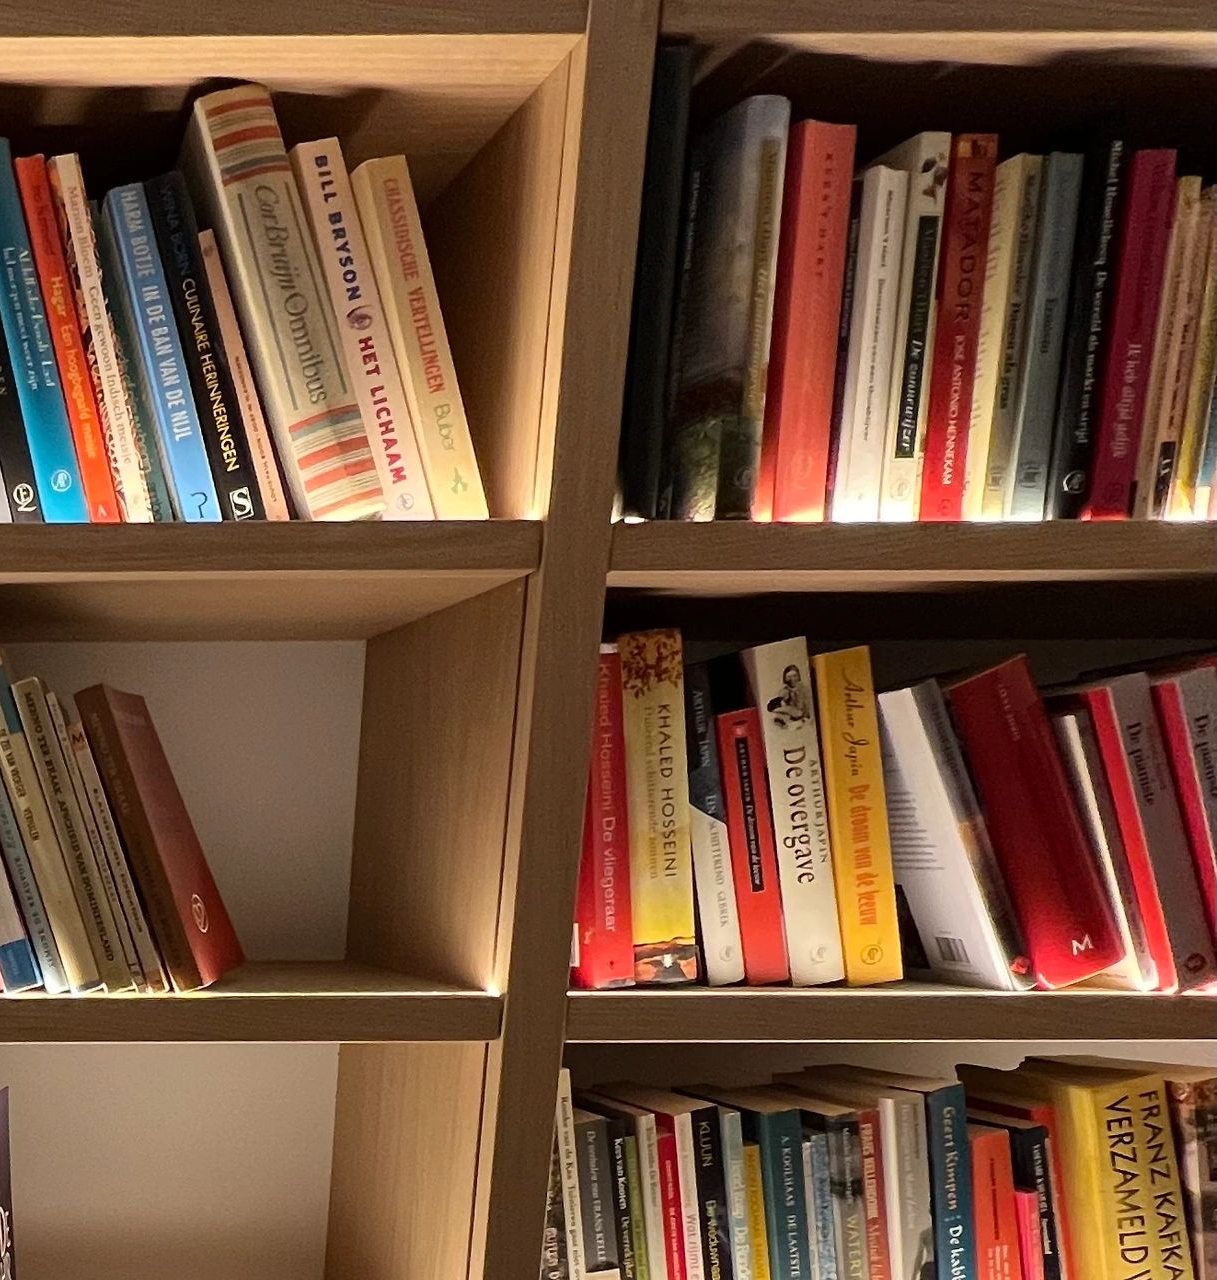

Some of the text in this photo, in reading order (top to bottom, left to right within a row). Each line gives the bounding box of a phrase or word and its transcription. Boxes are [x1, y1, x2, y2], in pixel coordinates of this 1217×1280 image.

[953, 171, 983, 323] MATADOR
[120, 190, 194, 442] HARM BOTJE IN DE BAN VAN DE NIJL
[183, 278, 240, 472] CULINAIRE HERINNERINGEN
[283, 291, 330, 405] Omnibus
[314, 154, 407, 486] BILL BRYSON HET LICHAAM
[383, 177, 456, 453] CHASSIDISCHE VERTELLINGEN Buber
[941, 419, 959, 487] HENNEKAM
[949, 364, 964, 419] ANTONIO
[597, 661, 618, 934] Khaled Hosseini De vliegeraar
[656, 703, 679, 879] KHALED HOSSEINI
[783, 745, 816, 885] De overgave
[841, 667, 879, 926] Arthur Japin De droom van de leeuw
[698, 1120, 712, 1168] KLUUN
[782, 1145, 795, 1207] KOOLHAAS
[943, 1106, 959, 1210] Geert Kimpen
[1105, 1095, 1149, 1265] VERZAMELD
[1138, 1089, 1170, 1186] FRANZ
[786, 1214, 796, 1230] DE
[788, 1231, 801, 1278] LAATSTE
[949, 1225, 963, 1245] De
